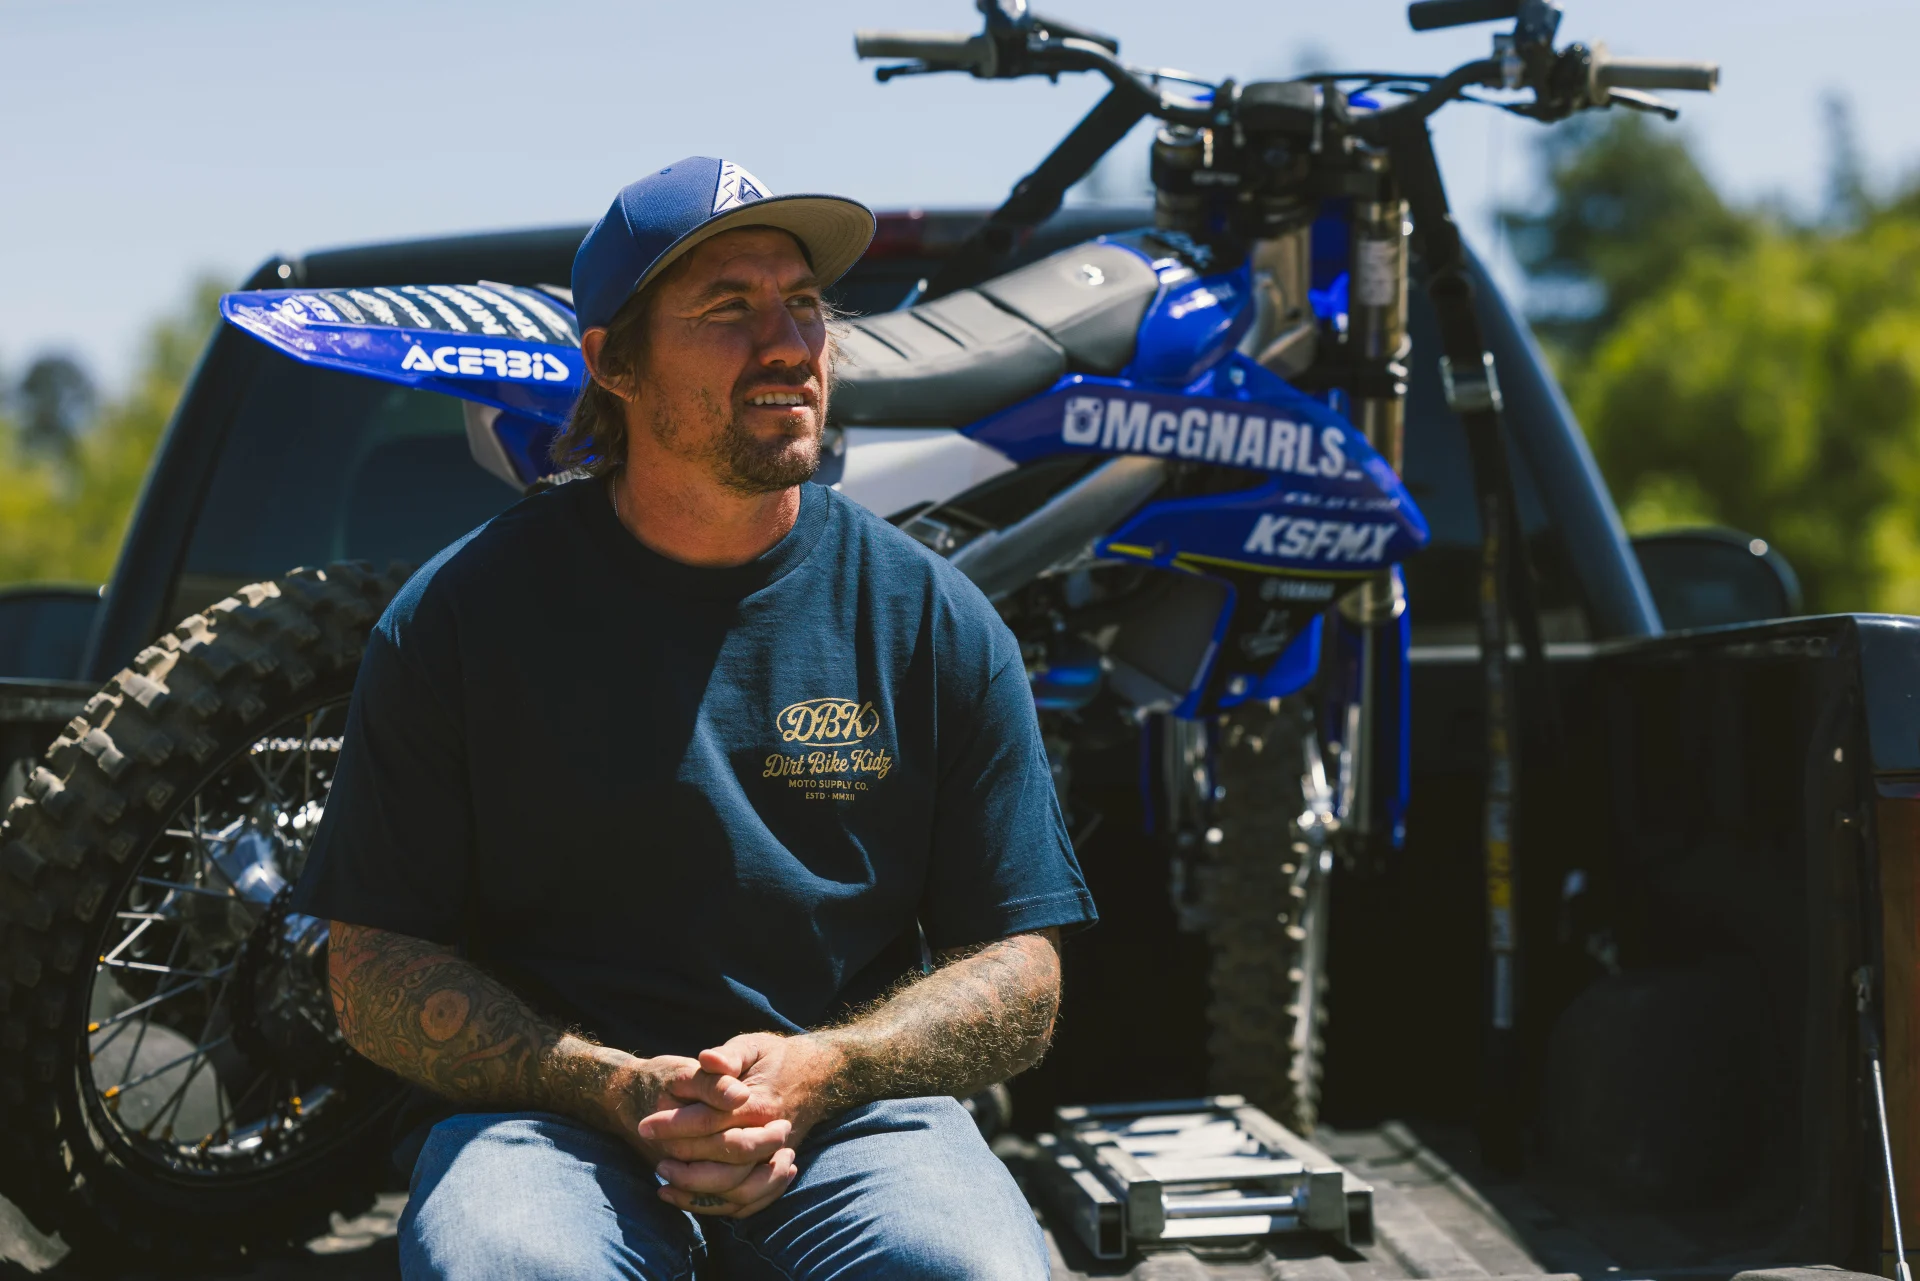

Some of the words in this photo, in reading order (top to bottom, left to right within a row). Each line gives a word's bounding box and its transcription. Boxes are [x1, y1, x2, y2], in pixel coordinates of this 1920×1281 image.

[1243, 513, 1397, 562] KSFMX
[782, 701, 873, 742] DBK
[762, 753, 806, 778] Dirt
[807, 751, 850, 776] Bike
[850, 748, 893, 780] Kidz
[788, 779, 817, 789] MOTO
[818, 780, 852, 790] SUPPLY
[854, 781, 869, 791] CO.
[805, 792, 826, 801] ESTD
[832, 793, 855, 802] MMXII
